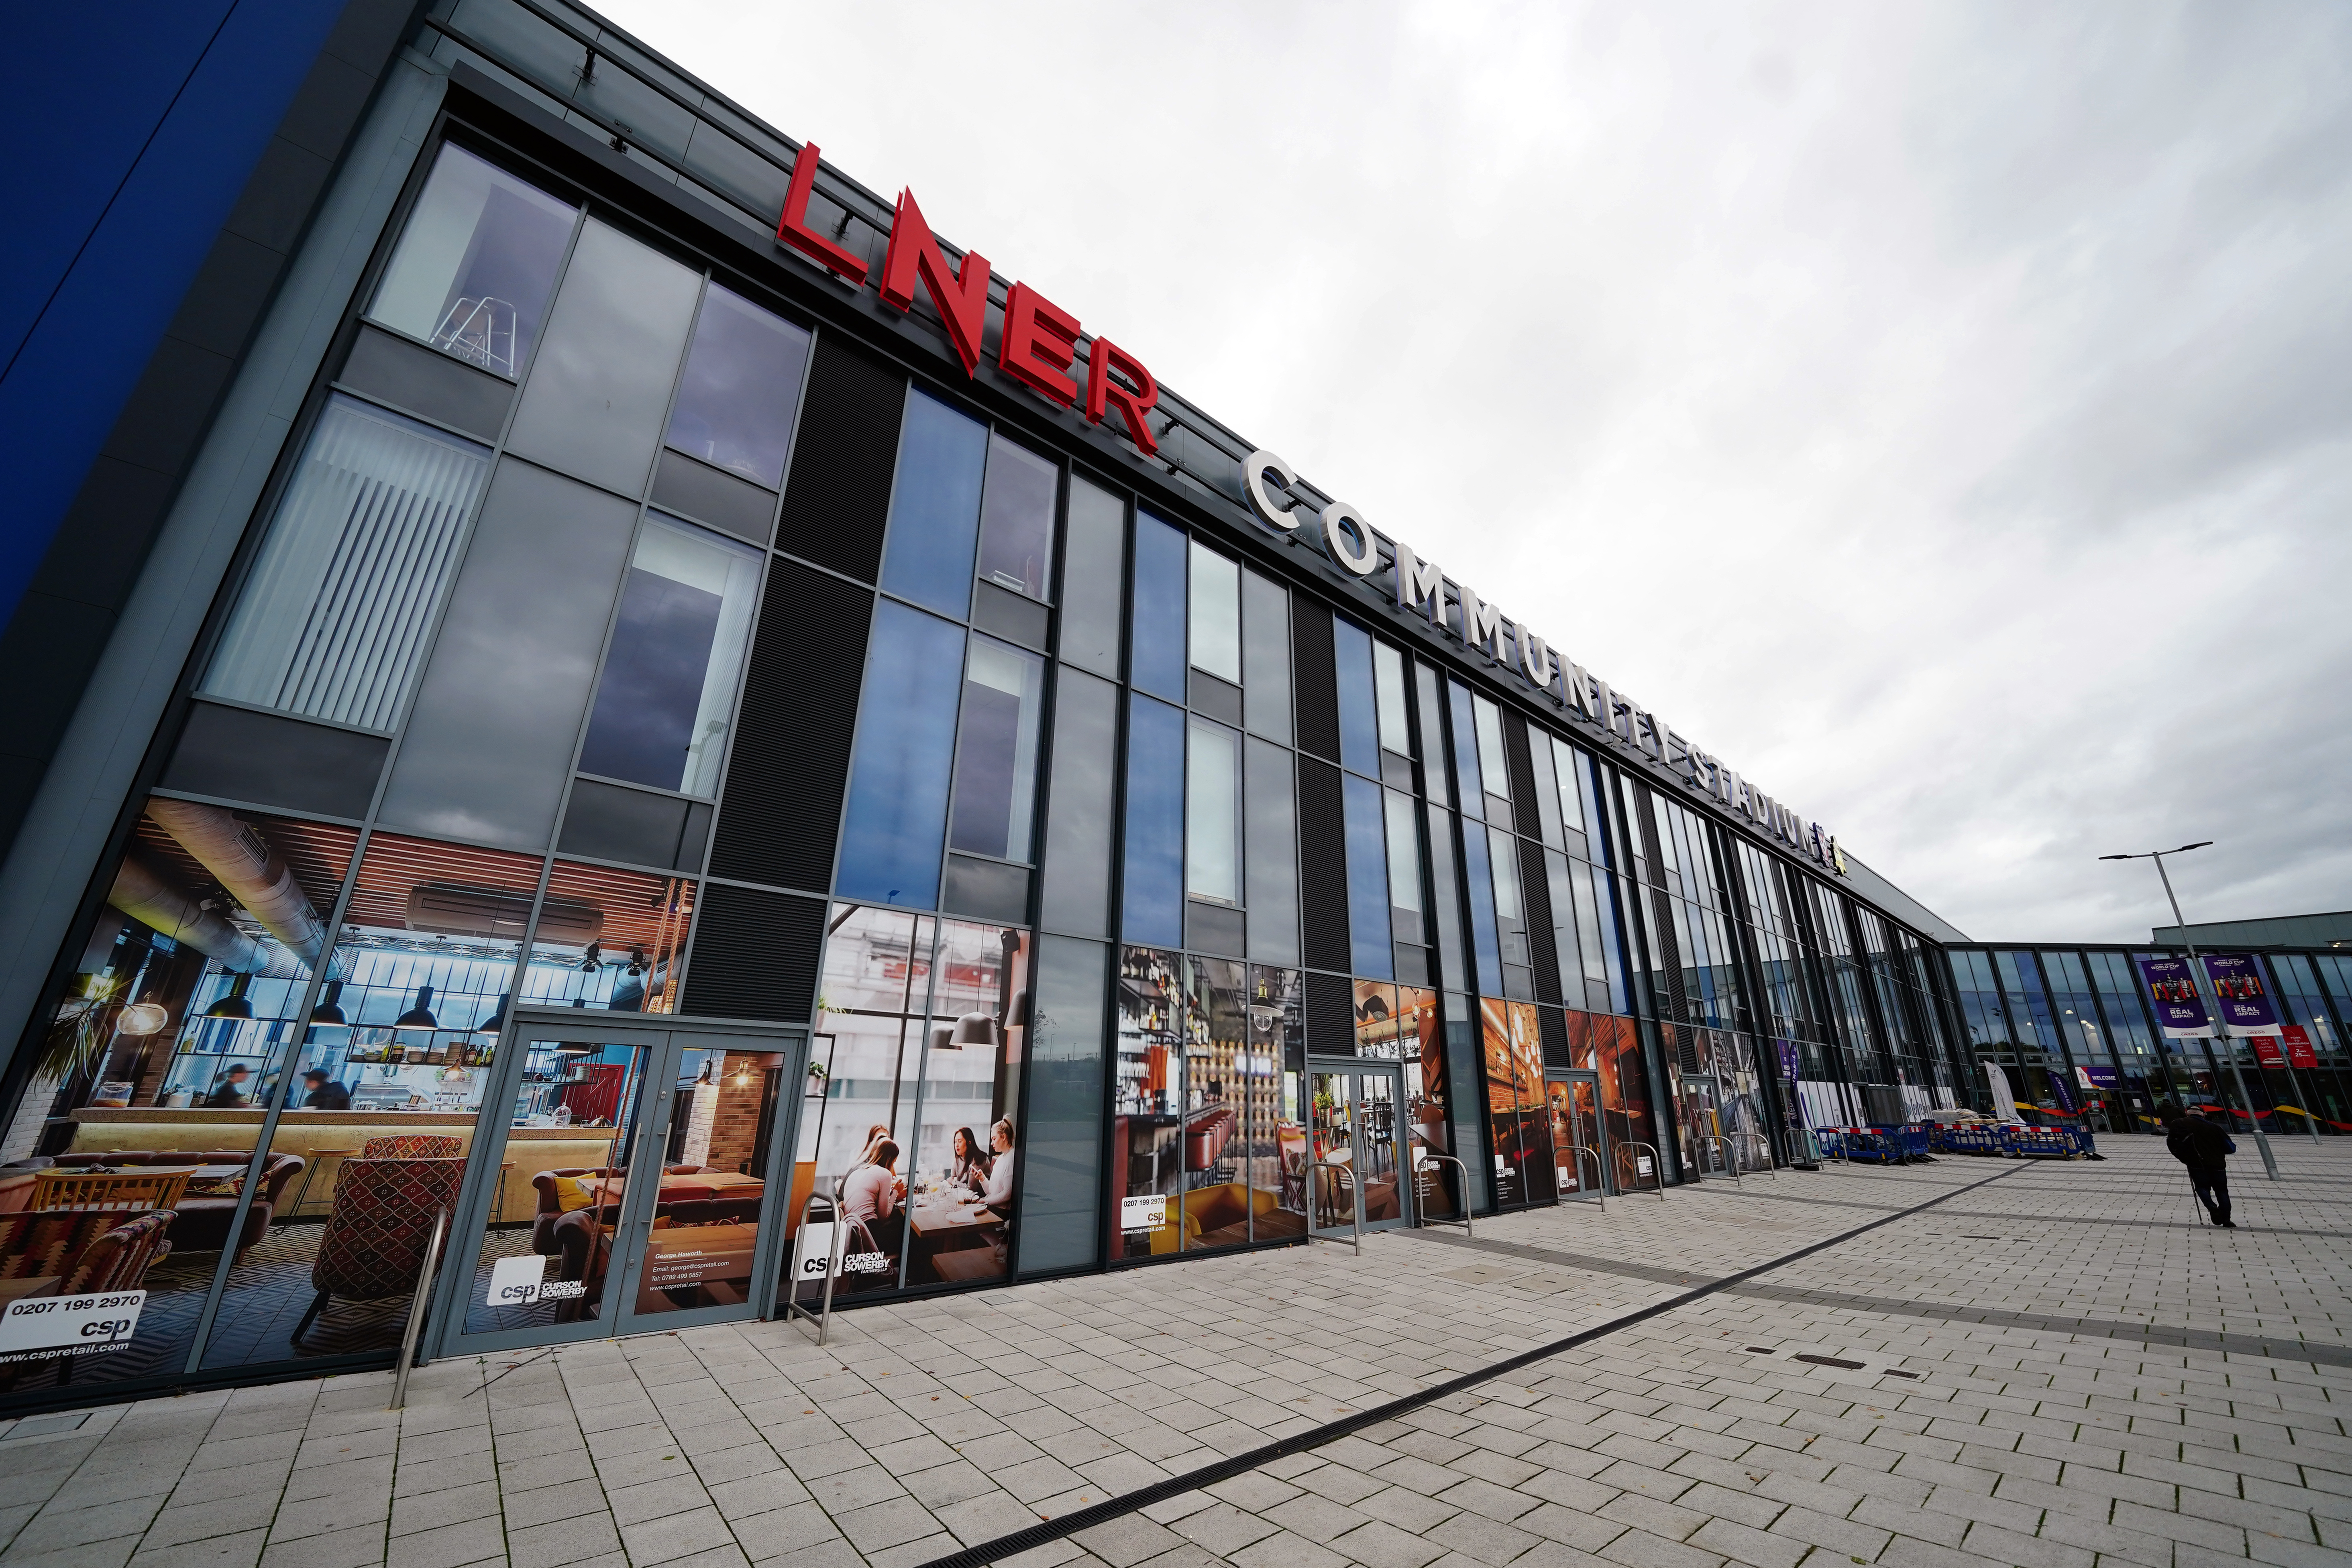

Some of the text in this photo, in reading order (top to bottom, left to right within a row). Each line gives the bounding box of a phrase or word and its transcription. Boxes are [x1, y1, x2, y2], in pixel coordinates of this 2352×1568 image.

[777, 141, 1158, 458] LNER
[1240, 449, 1816, 856] COMMUNITY STADIUM
[2066, 1098, 2074, 1111] MAIN
[1147, 1211, 1163, 1224] csp
[1121, 1226, 1166, 1235] www.cspretail.com
[845, 1251, 884, 1263] CURSON
[671, 1261, 729, 1272] george@cspretail.com
[844, 1258, 891, 1272] SOWERBY
[540, 1286, 588, 1297] SOWERBY
[542, 1280, 582, 1290] CURSON
[650, 1281, 701, 1291] www.cspretail.com
[501, 1285, 535, 1303] csp
[12, 1295, 140, 1316] 0207 199 2970
[80, 1319, 130, 1341] csp
[0, 1342, 129, 1363] ww.cspretail.com
